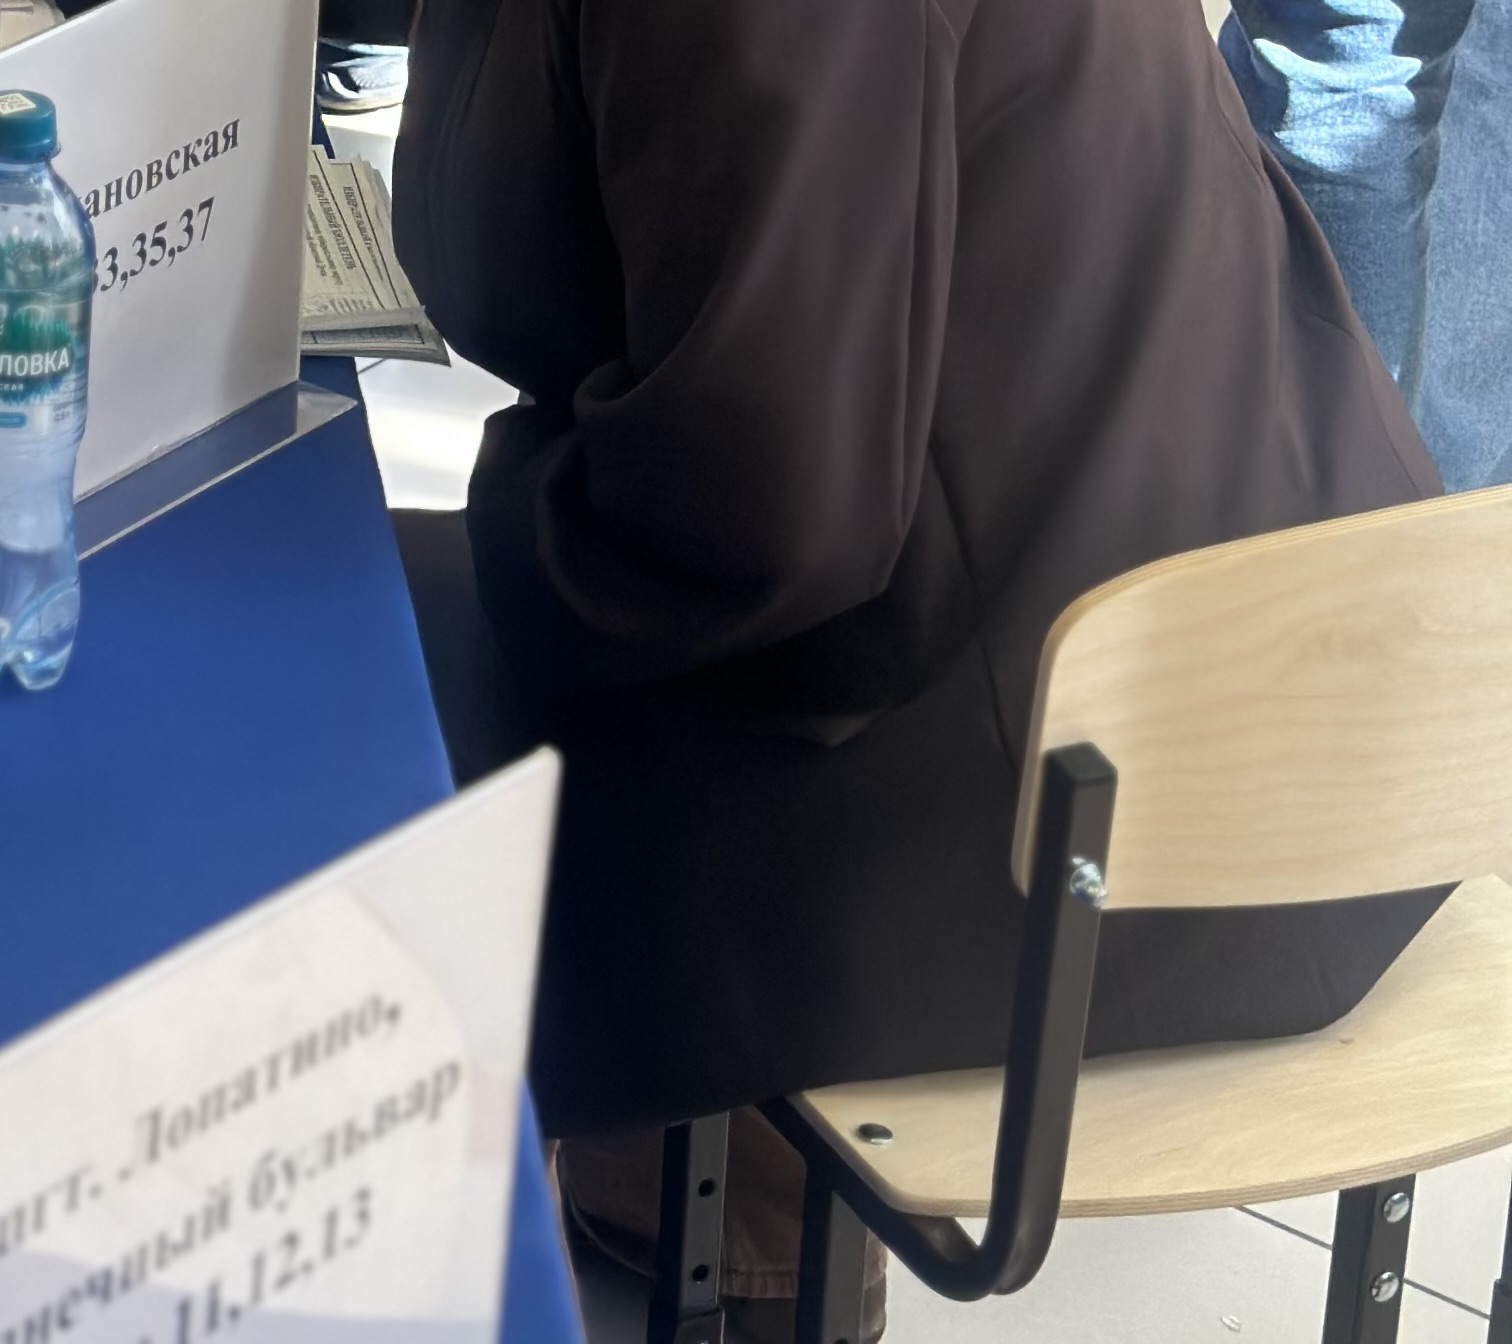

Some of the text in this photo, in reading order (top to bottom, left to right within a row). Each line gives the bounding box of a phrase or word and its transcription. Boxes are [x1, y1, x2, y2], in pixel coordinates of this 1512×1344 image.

[79, 118, 240, 219] ановская
[117, 994, 403, 1170] Лопатино,
[245, 1060, 462, 1216] бульвар
